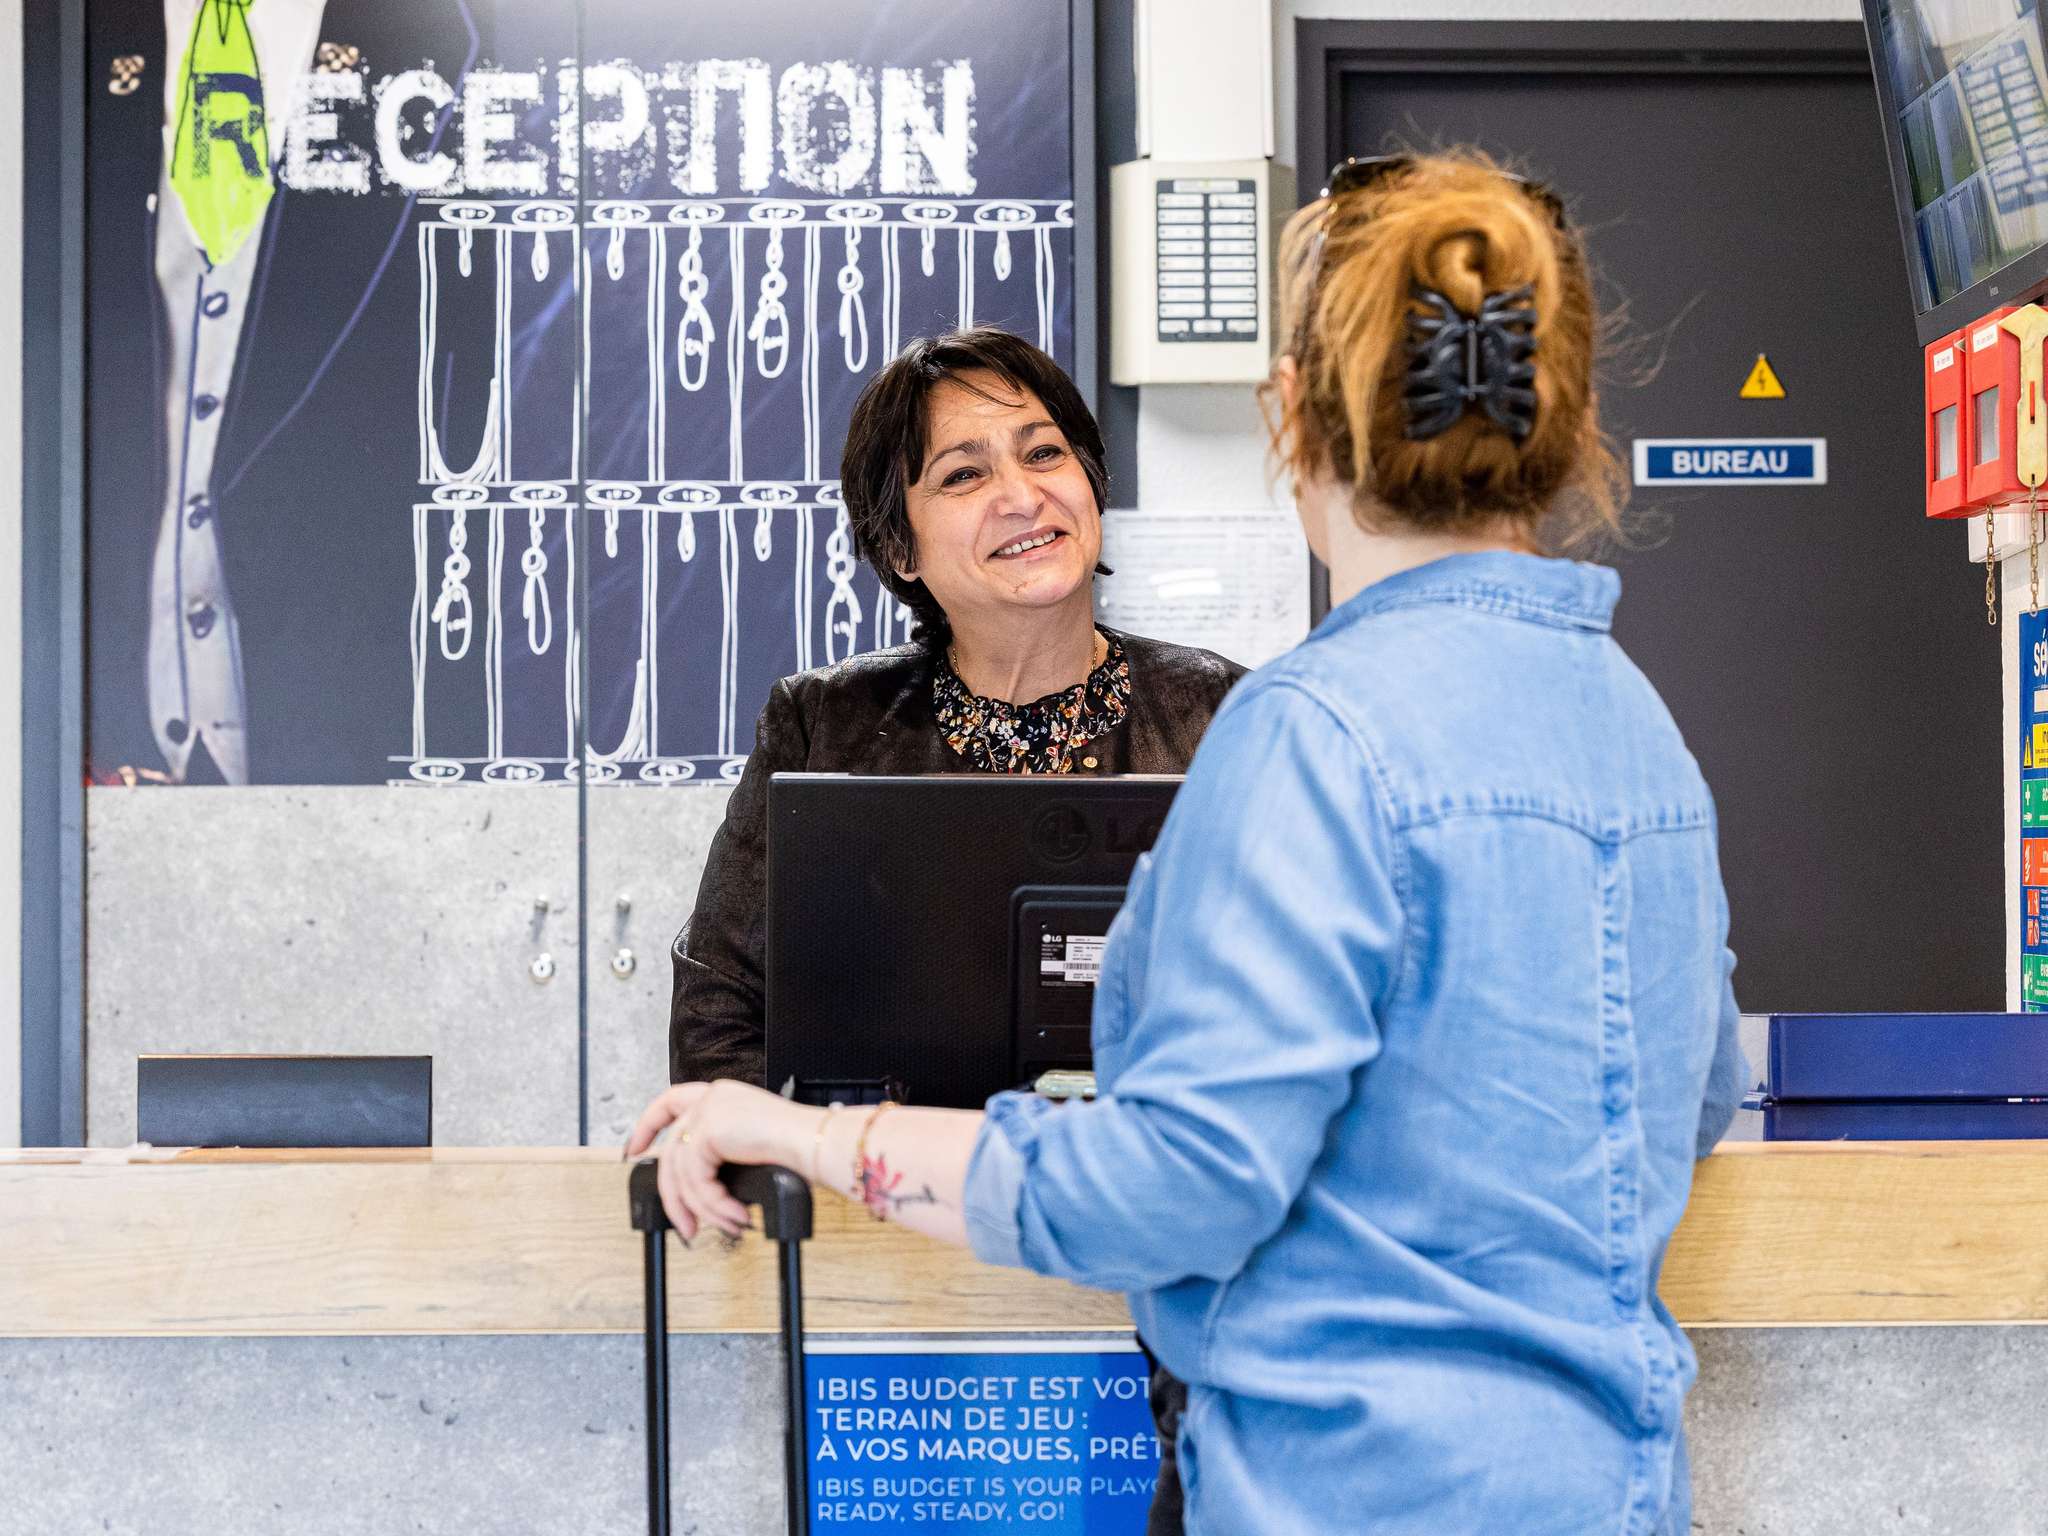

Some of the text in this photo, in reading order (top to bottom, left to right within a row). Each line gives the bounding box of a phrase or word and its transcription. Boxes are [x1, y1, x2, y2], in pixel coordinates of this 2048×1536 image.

[192, 60, 977, 196] RECEPTION
[1672, 450, 1788, 474] BUREAU
[818, 1377, 877, 1401] IBIS
[888, 1376, 1019, 1401] BUDGET
[1029, 1376, 1084, 1401] EST
[816, 1407, 952, 1432] TERRAIN
[964, 1406, 1006, 1431] DE
[816, 1434, 838, 1461] À
[845, 1437, 909, 1462] VOS
[918, 1436, 1080, 1465] MARQUES,
[818, 1478, 864, 1497] IBIS
[873, 1477, 975, 1497] BUDGET
[984, 1477, 1005, 1497] IS
[1012, 1477, 1082, 1496] YOUR
[818, 1501, 1064, 1523] READY, STEADY, GO!
